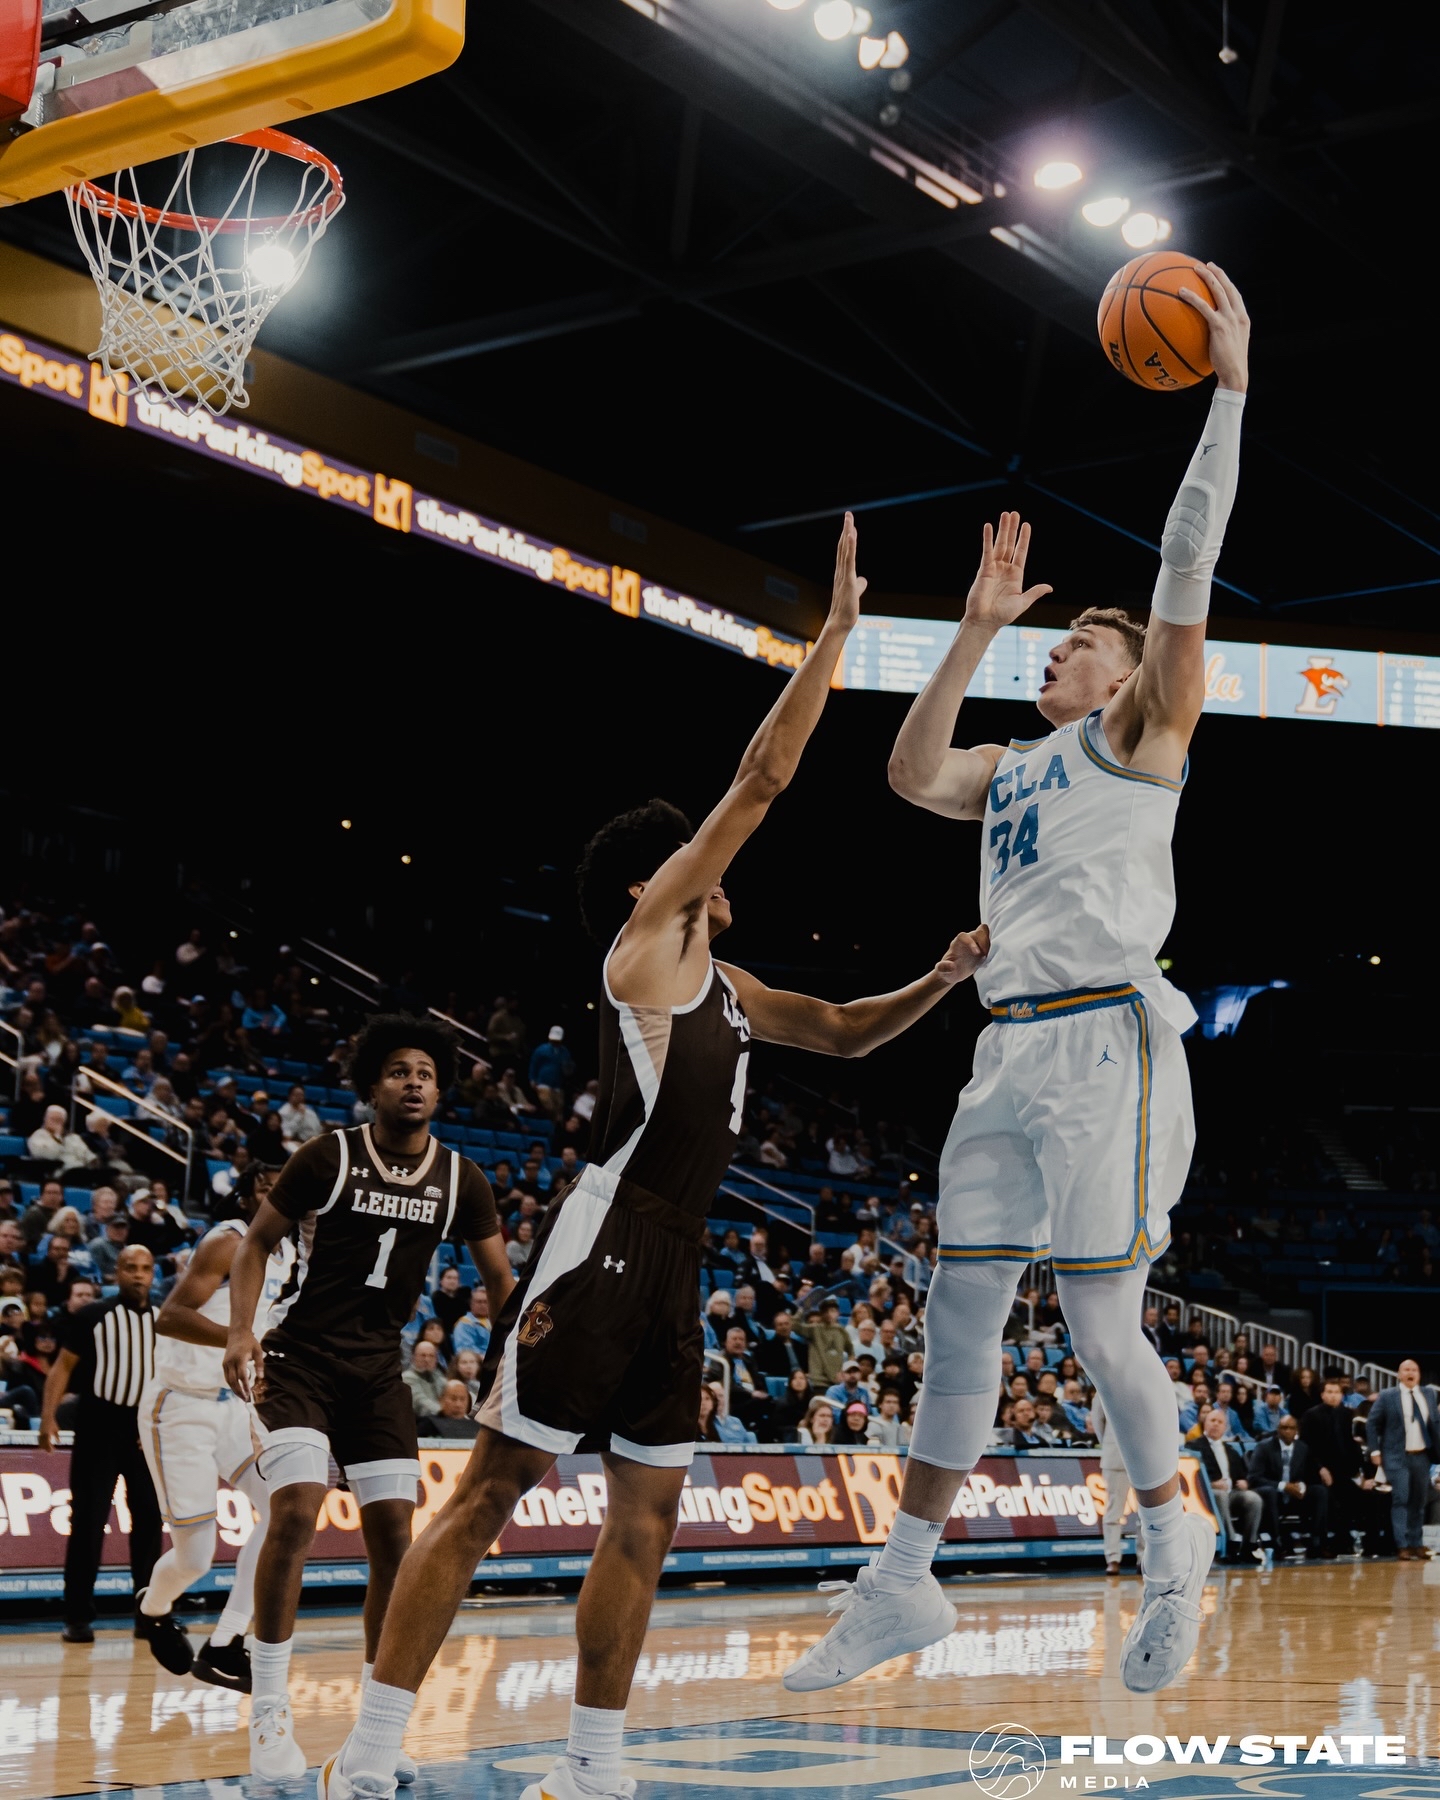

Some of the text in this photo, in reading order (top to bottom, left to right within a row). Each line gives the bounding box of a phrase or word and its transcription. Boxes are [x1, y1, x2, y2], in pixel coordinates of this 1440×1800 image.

[0, 334, 84, 398] Spot
[1144, 351, 1183, 389] CLA
[989, 754, 1071, 814] CLA
[989, 802, 1039, 885] 34
[351, 1188, 438, 1224] LEHIGH
[365, 1227, 397, 1289] 1
